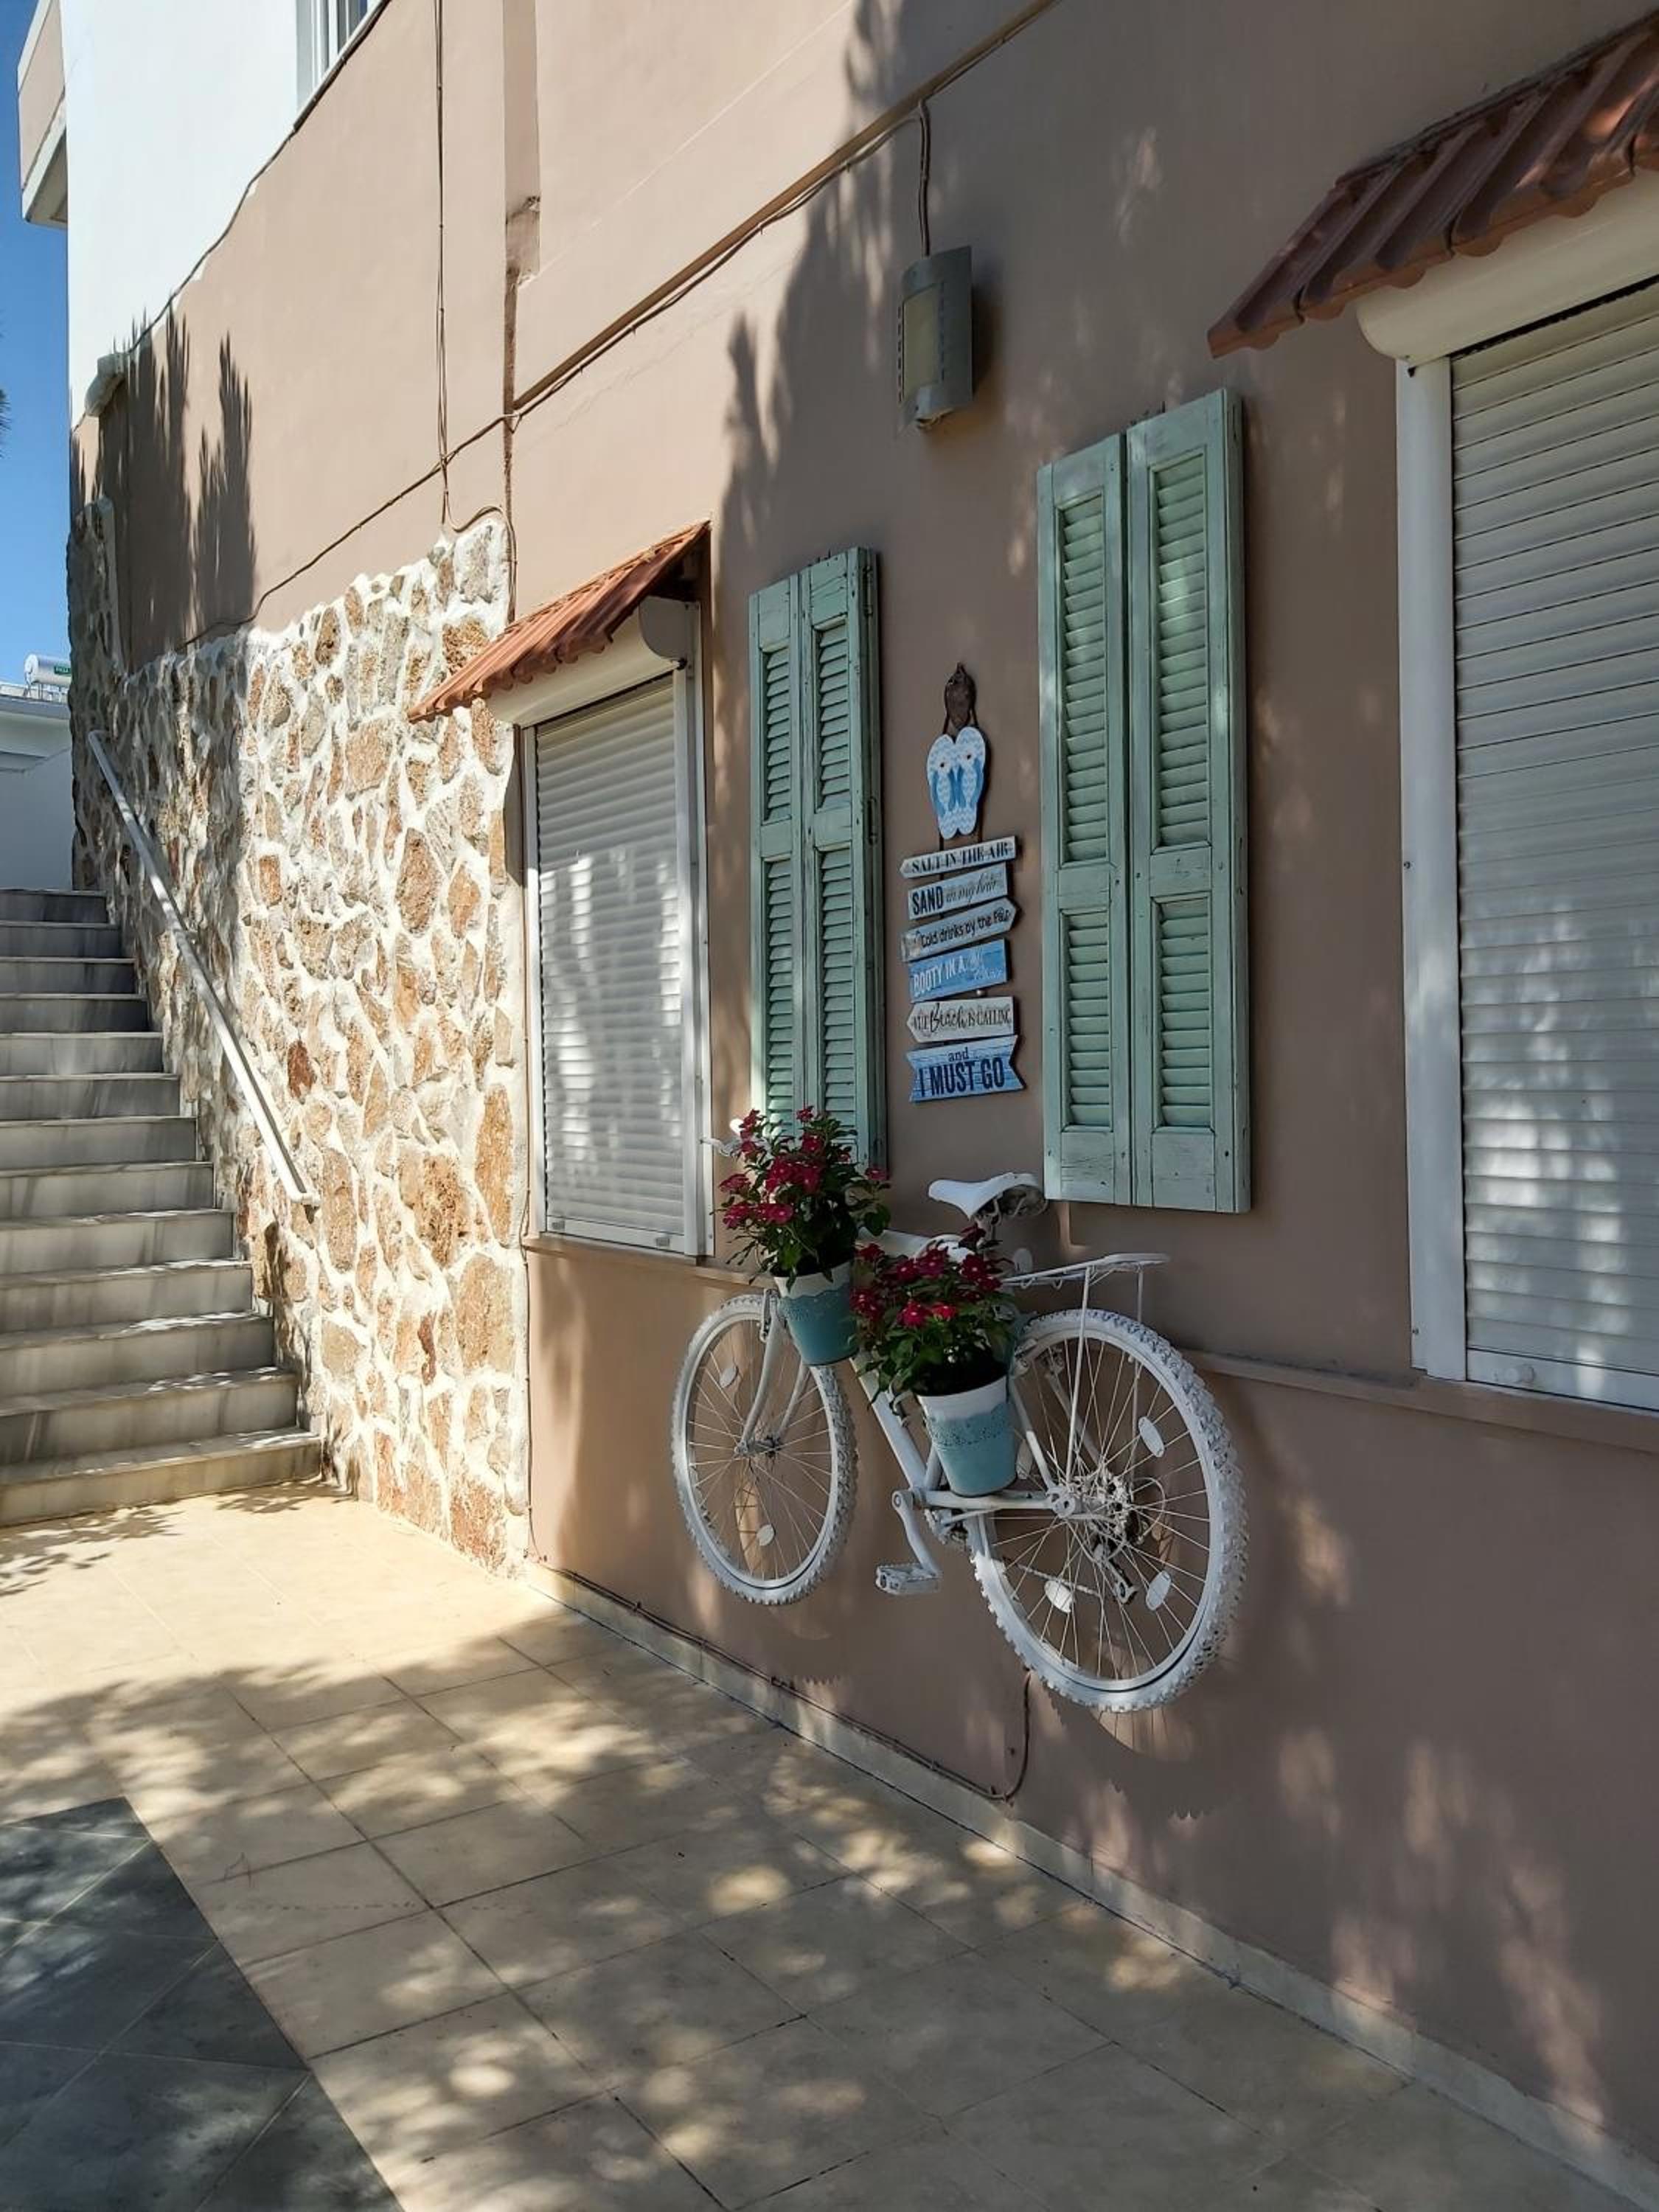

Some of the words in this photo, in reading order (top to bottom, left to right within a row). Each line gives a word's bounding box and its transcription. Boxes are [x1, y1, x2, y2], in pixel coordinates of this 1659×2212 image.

[961, 847, 984, 865] THE
[989, 842, 1009, 859] AIR
[912, 886, 943, 915] SAND
[940, 924, 964, 942] drinks
[965, 919, 975, 936] by
[978, 916, 992, 929] the
[914, 963, 943, 995] BOOTY
[945, 957, 956, 979] IN
[959, 955, 968, 973] A
[930, 1002, 966, 1032] Beach
[968, 1007, 977, 1027] IS
[948, 1047, 970, 1062] and
[919, 1068, 926, 1097] I
[930, 1060, 976, 1096] MUST
[981, 1057, 1005, 1089] GO
